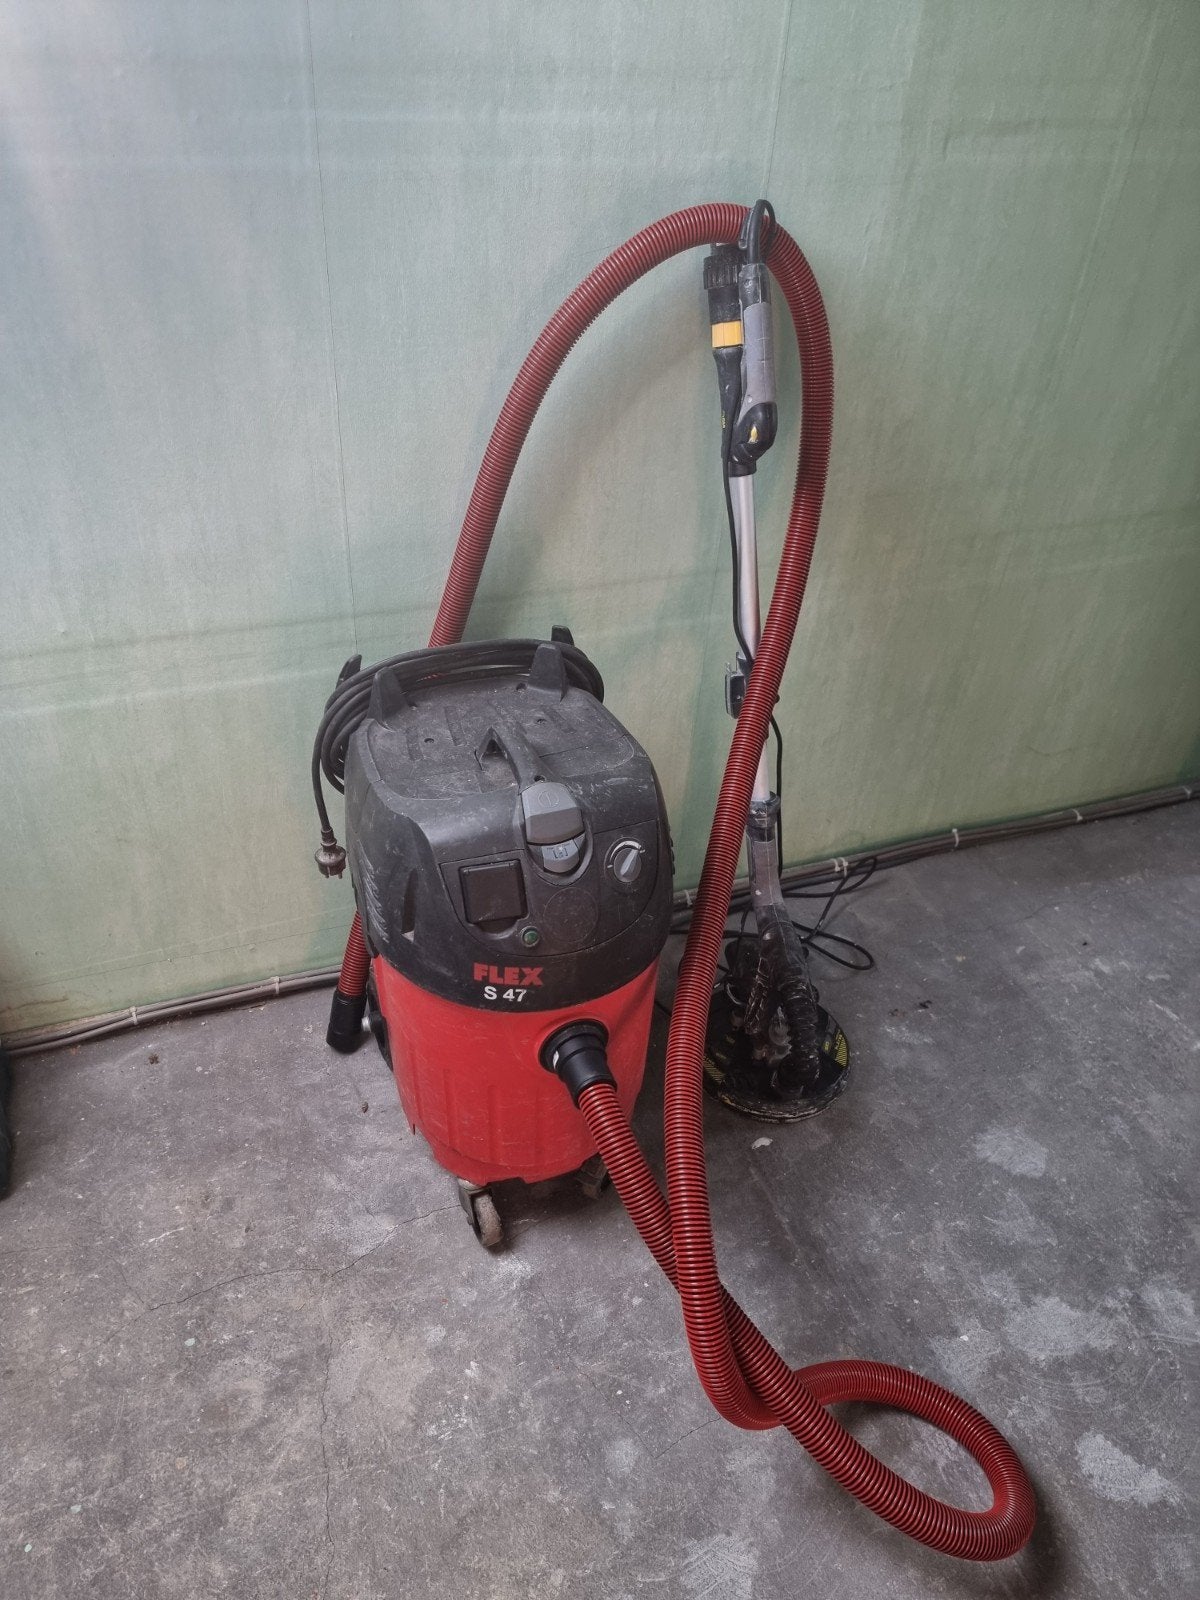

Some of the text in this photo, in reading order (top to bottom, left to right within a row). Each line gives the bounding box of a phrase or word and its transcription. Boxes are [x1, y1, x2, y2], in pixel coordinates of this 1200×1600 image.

[473, 963, 543, 985] FLEX
[483, 985, 527, 1002] S 47
